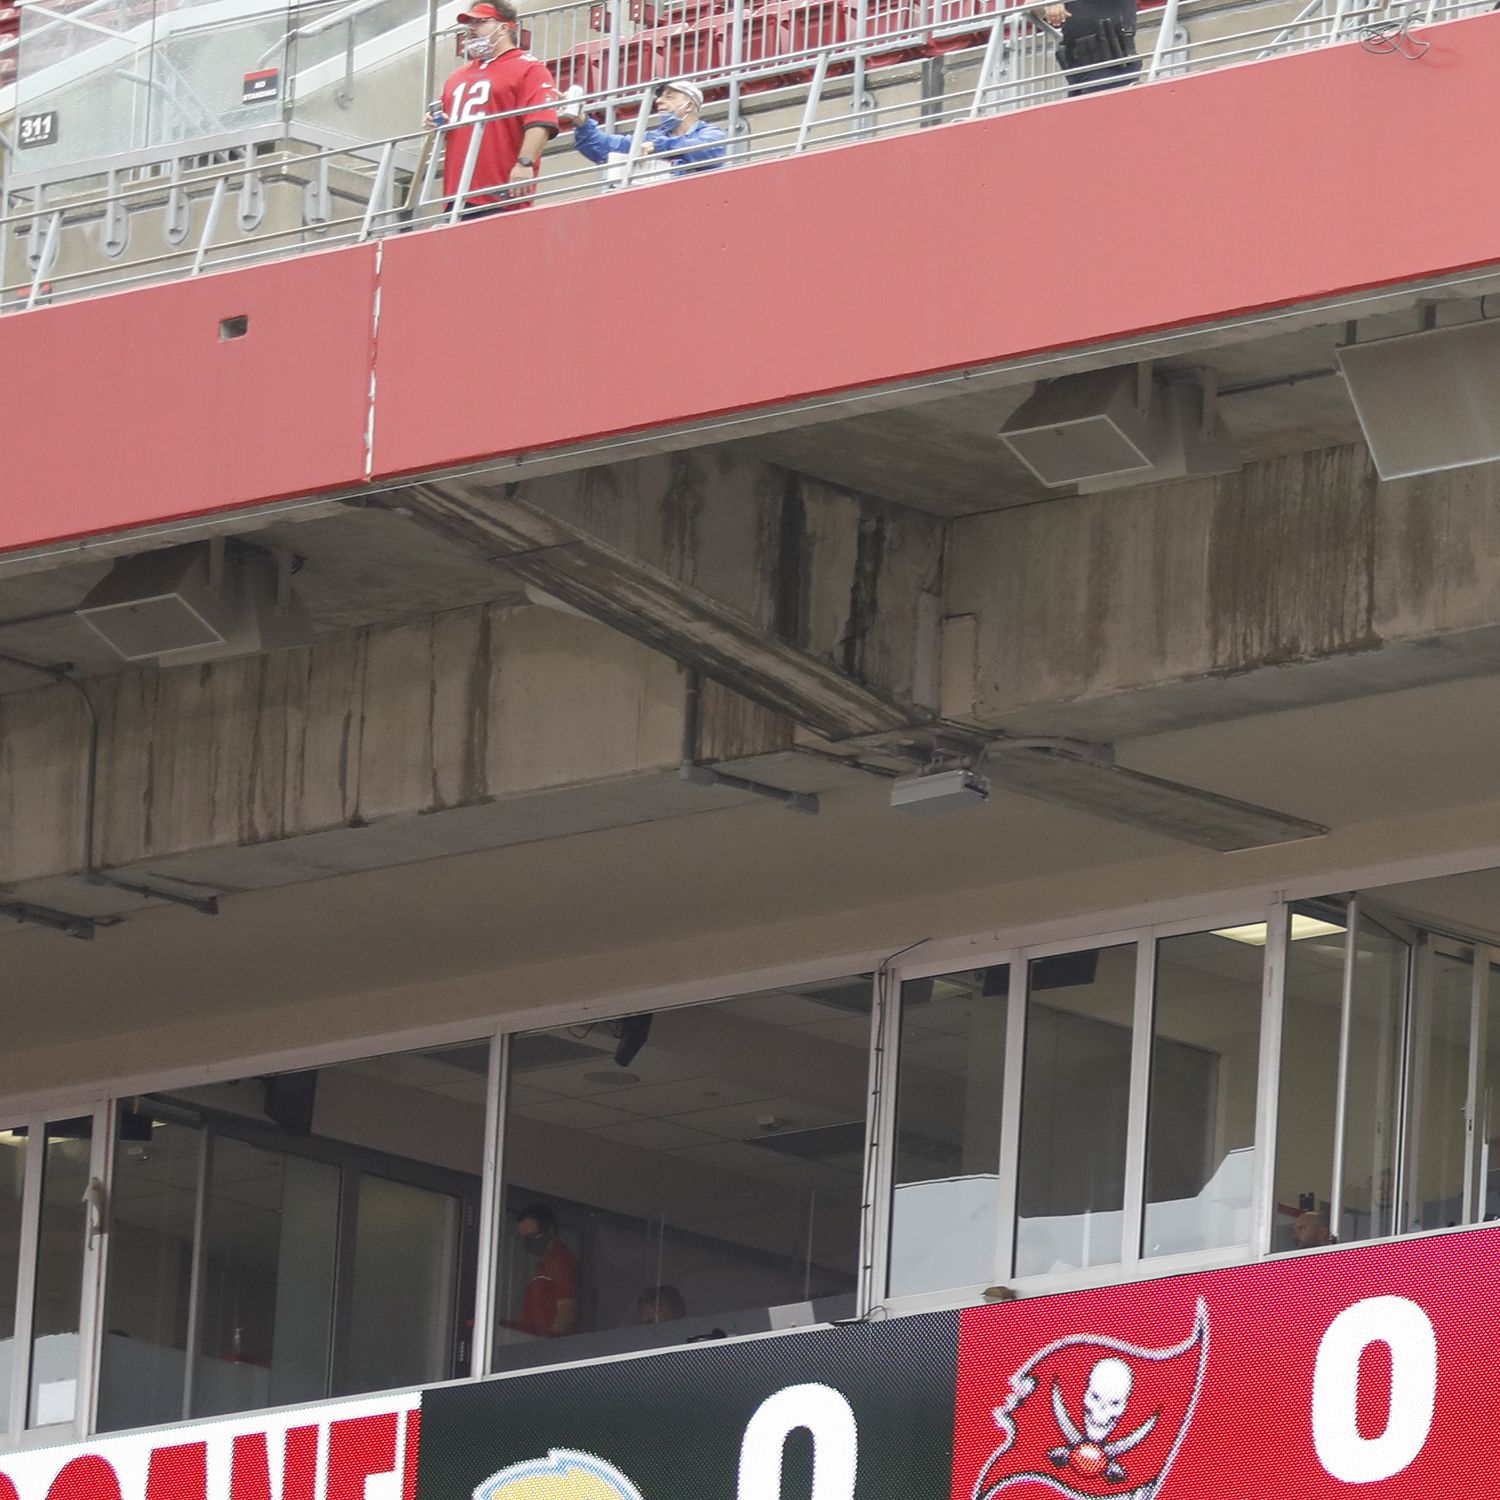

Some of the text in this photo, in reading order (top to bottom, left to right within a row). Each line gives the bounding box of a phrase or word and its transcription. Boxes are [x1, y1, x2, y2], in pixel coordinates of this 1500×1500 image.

[450, 80, 491, 124] 12
[21, 115, 52, 138] 311
[1311, 1295, 1438, 1484] 0
